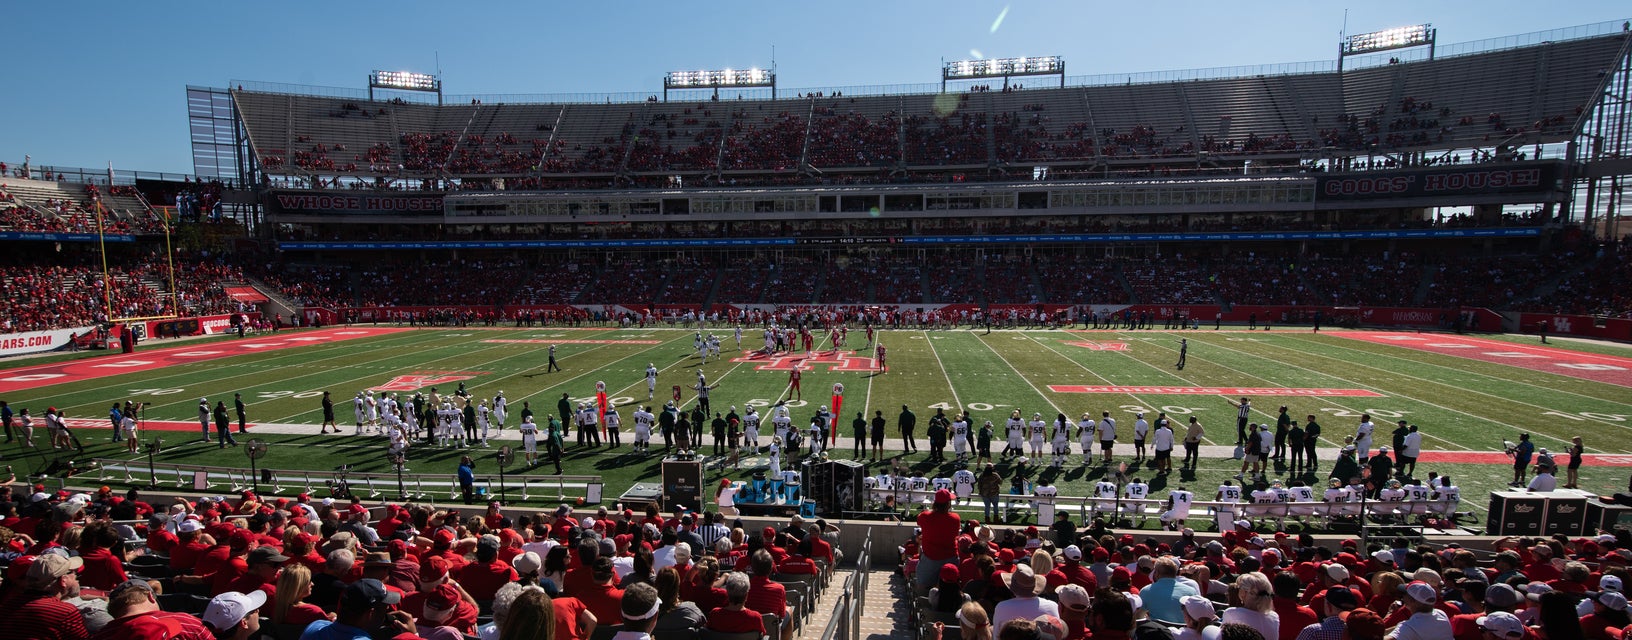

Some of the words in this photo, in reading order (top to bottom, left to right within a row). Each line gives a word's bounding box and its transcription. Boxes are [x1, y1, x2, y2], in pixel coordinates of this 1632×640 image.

[1325, 175, 1415, 196] COOGS'
[1424, 169, 1540, 191] HOUSE!
[277, 195, 360, 210] WHOSE
[366, 197, 443, 211] HOUSE?
[638, 417, 647, 425] 70
[959, 476, 970, 484] 36
[913, 481, 924, 489] 20
[936, 482, 948, 490] 27
[1102, 485, 1114, 493] 44
[1131, 486, 1143, 495] 12
[1226, 490, 1239, 499] 93
[1301, 490, 1312, 499] 91
[1179, 493, 1187, 503] 4
[1413, 491, 1427, 500] 94
[1446, 493, 1456, 501] 15
